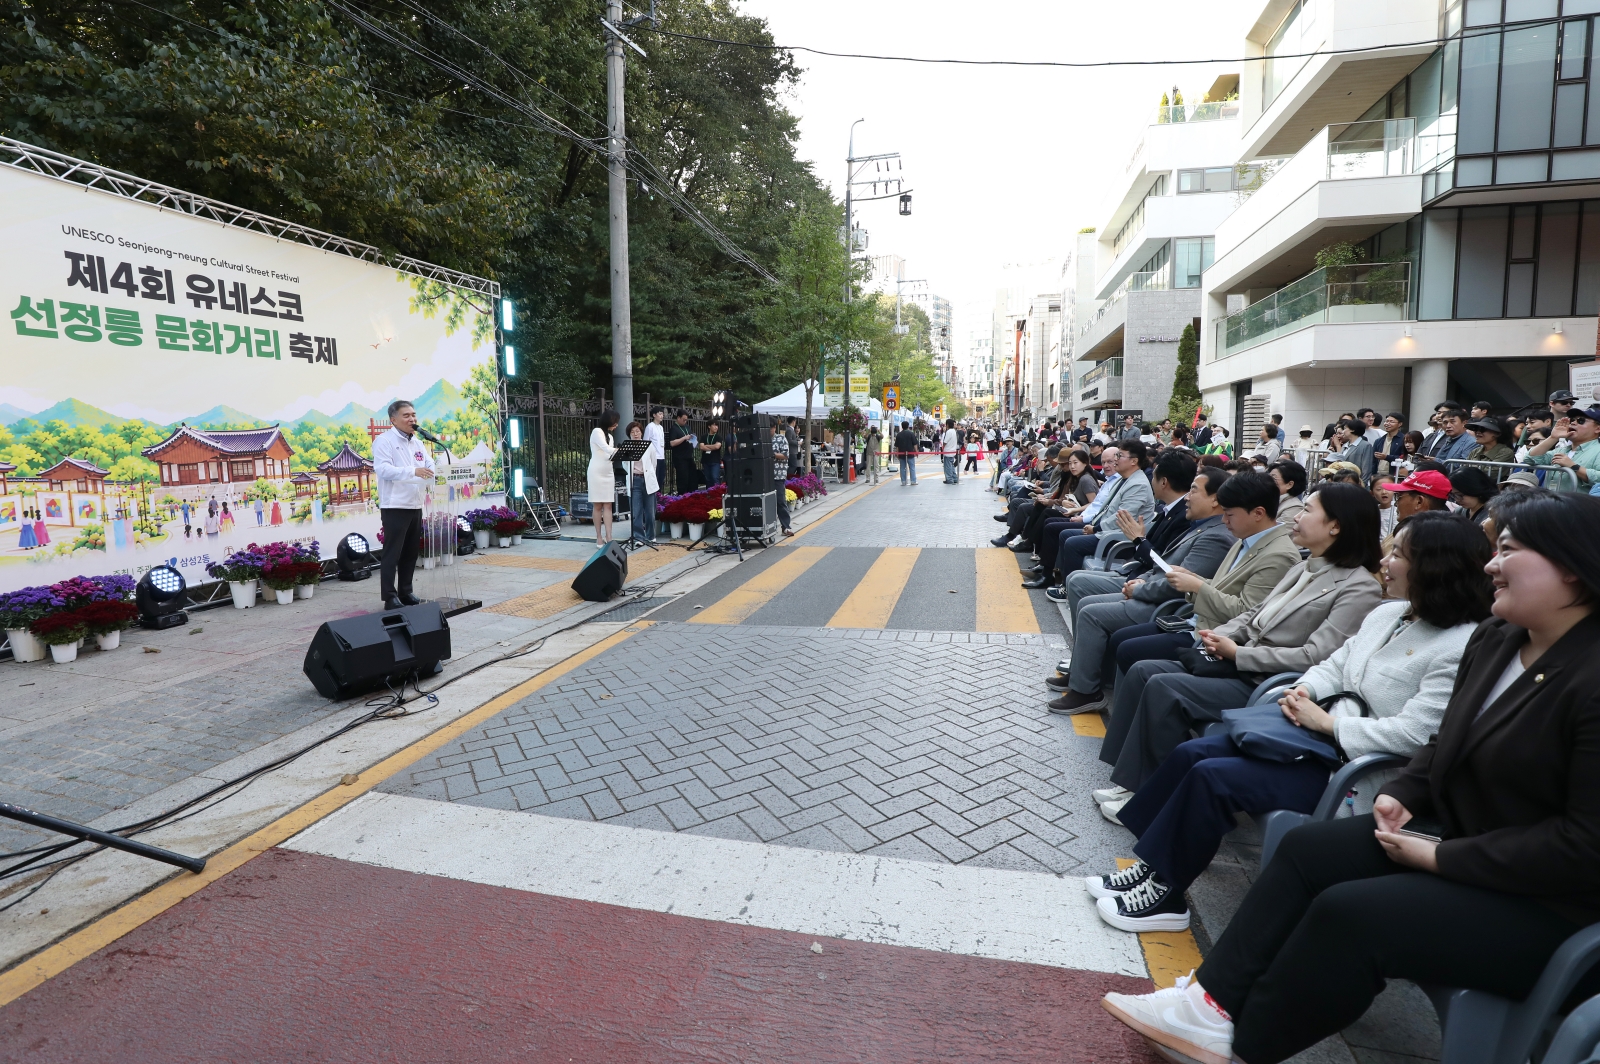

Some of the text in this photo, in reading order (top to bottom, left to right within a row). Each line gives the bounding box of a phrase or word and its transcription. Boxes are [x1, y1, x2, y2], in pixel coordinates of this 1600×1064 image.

[61, 224, 300, 284] UNESCO Seonjeong-neung Cultural Street Festival
[64, 250, 305, 323] 제4회 유네스코
[10, 294, 339, 366] 선정릉 문화거리 축제
[179, 553, 211, 568] 삼성2동
